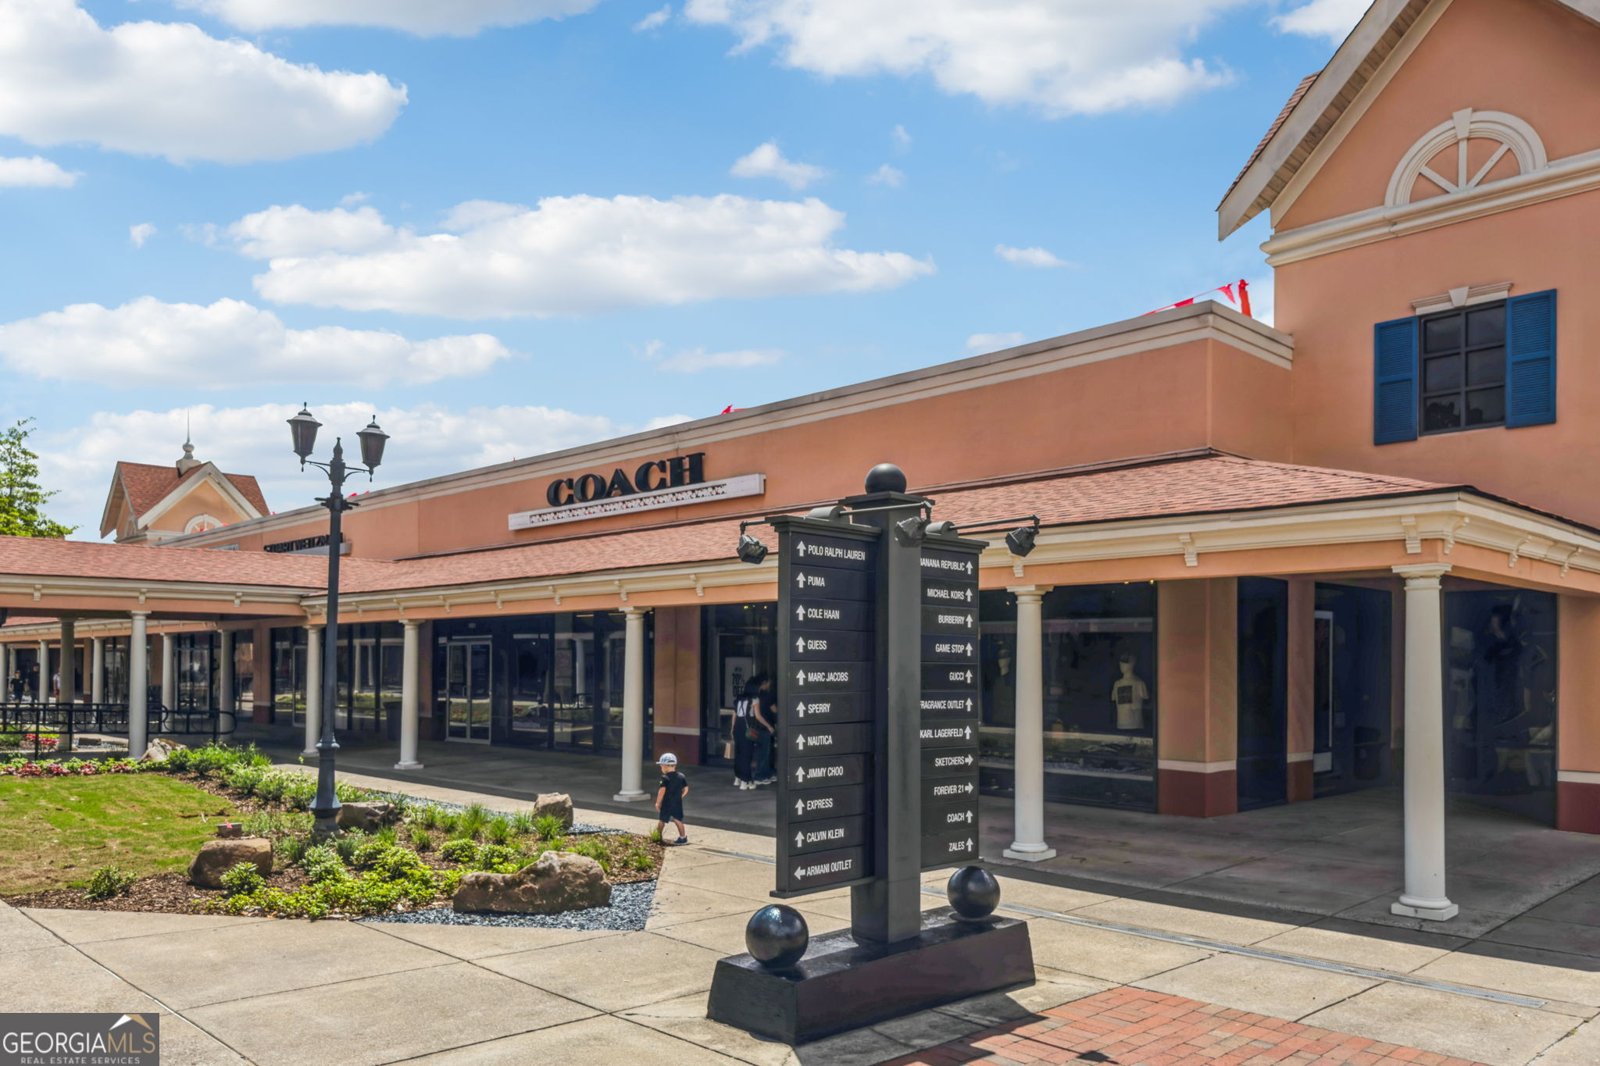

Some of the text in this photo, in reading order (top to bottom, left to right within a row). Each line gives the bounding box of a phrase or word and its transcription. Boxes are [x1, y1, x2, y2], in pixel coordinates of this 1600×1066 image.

[546, 452, 706, 507] COACH
[807, 544, 866, 561] POLO RALPH LAUREN
[940, 559, 966, 571] REPUBLIC
[807, 575, 826, 587] PUMA
[927, 588, 965, 600] MICHAEL KORS
[807, 608, 840, 620] COLE HAAN
[938, 614, 965, 625] BURBERRY
[807, 639, 828, 651] GUESS
[935, 643, 965, 654] GAME STOP
[807, 671, 849, 682] MARC JACOBS
[949, 671, 965, 681] GUCCI
[807, 702, 831, 714] SPERRY
[947, 700, 965, 710] OUTLET
[920, 728, 964, 739] KARL LAGERFELD
[807, 735, 833, 746] NAUTICA
[934, 755, 965, 767] SKETCHERS
[806, 766, 844, 779] JIMMY CHOO
[933, 784, 965, 796] FOREVER 21
[806, 798, 833, 810] EXPRESS
[946, 813, 965, 823] COACH
[806, 828, 845, 843] CALVIN KLEIN
[948, 841, 965, 852] ZALES
[806, 859, 852, 877] ARMANI OUTLET
